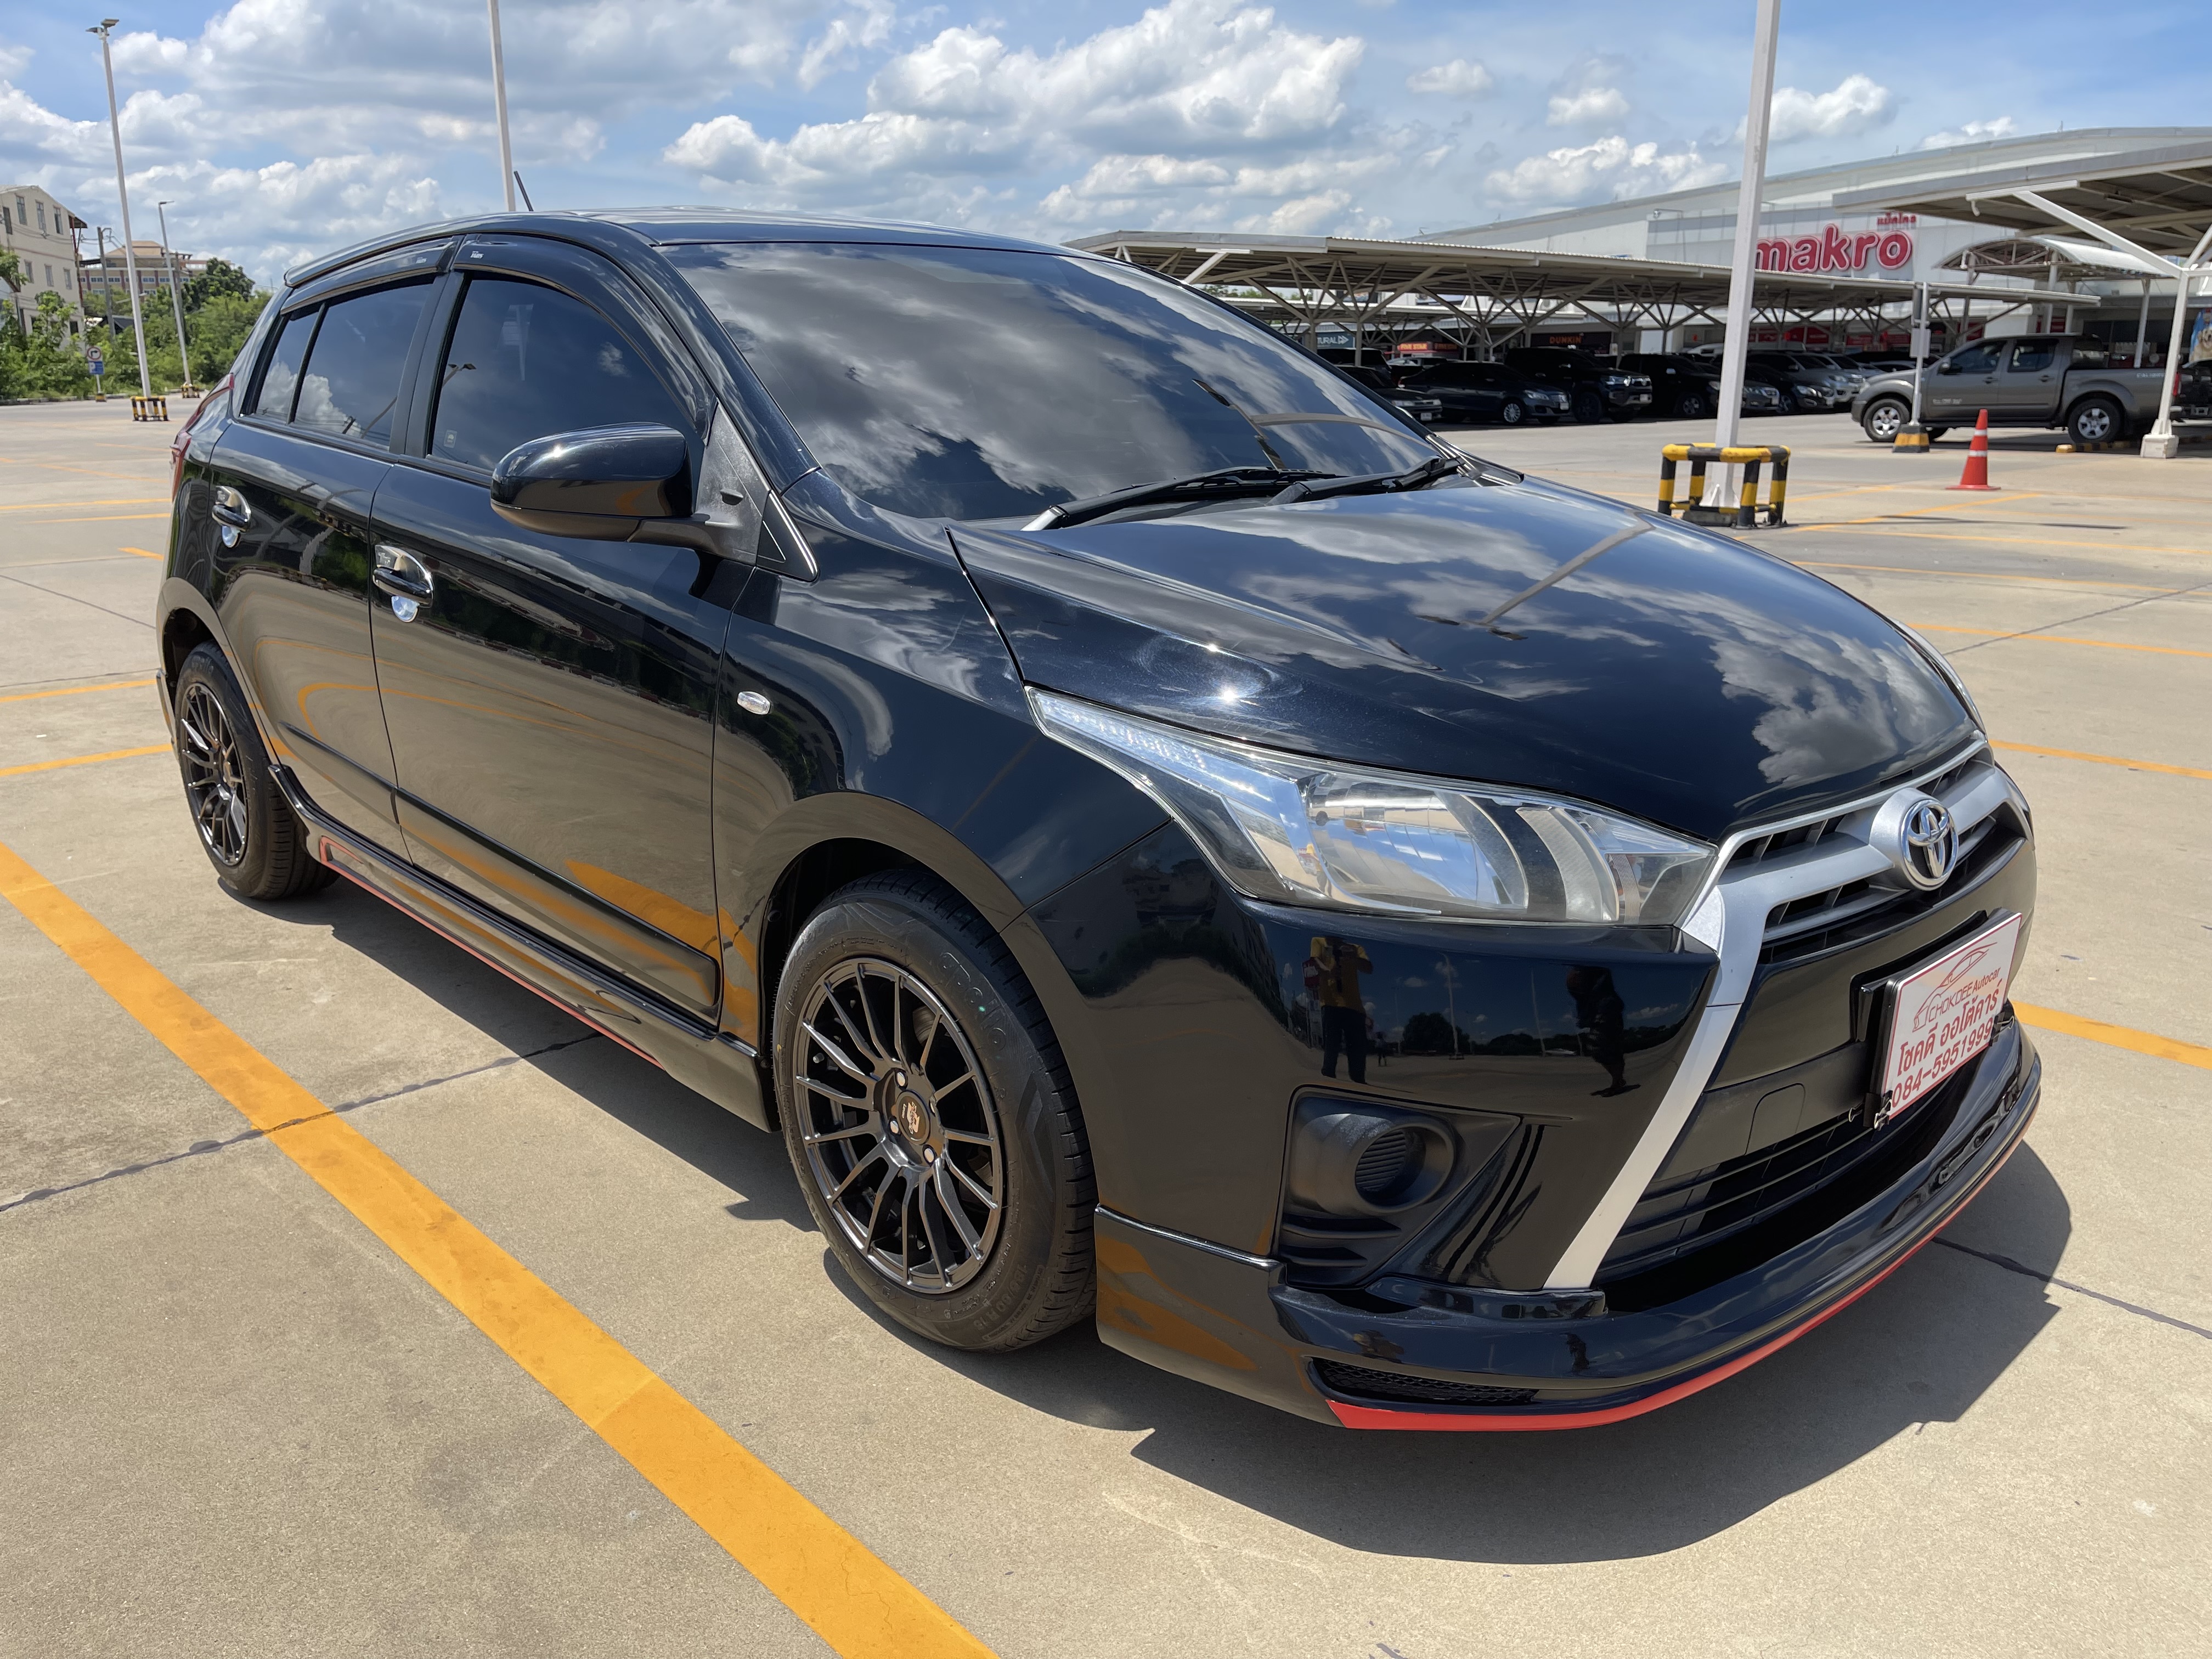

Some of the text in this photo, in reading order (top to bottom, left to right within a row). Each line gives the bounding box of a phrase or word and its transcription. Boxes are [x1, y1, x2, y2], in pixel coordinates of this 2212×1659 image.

[1756, 223, 1912, 273] makro
[1897, 978, 2003, 1077] โชคดี ออโต้คาร์
[1928, 967, 2001, 1023] CHOKDEE Autocar
[1892, 1017, 1994, 1108] 084-5951999
